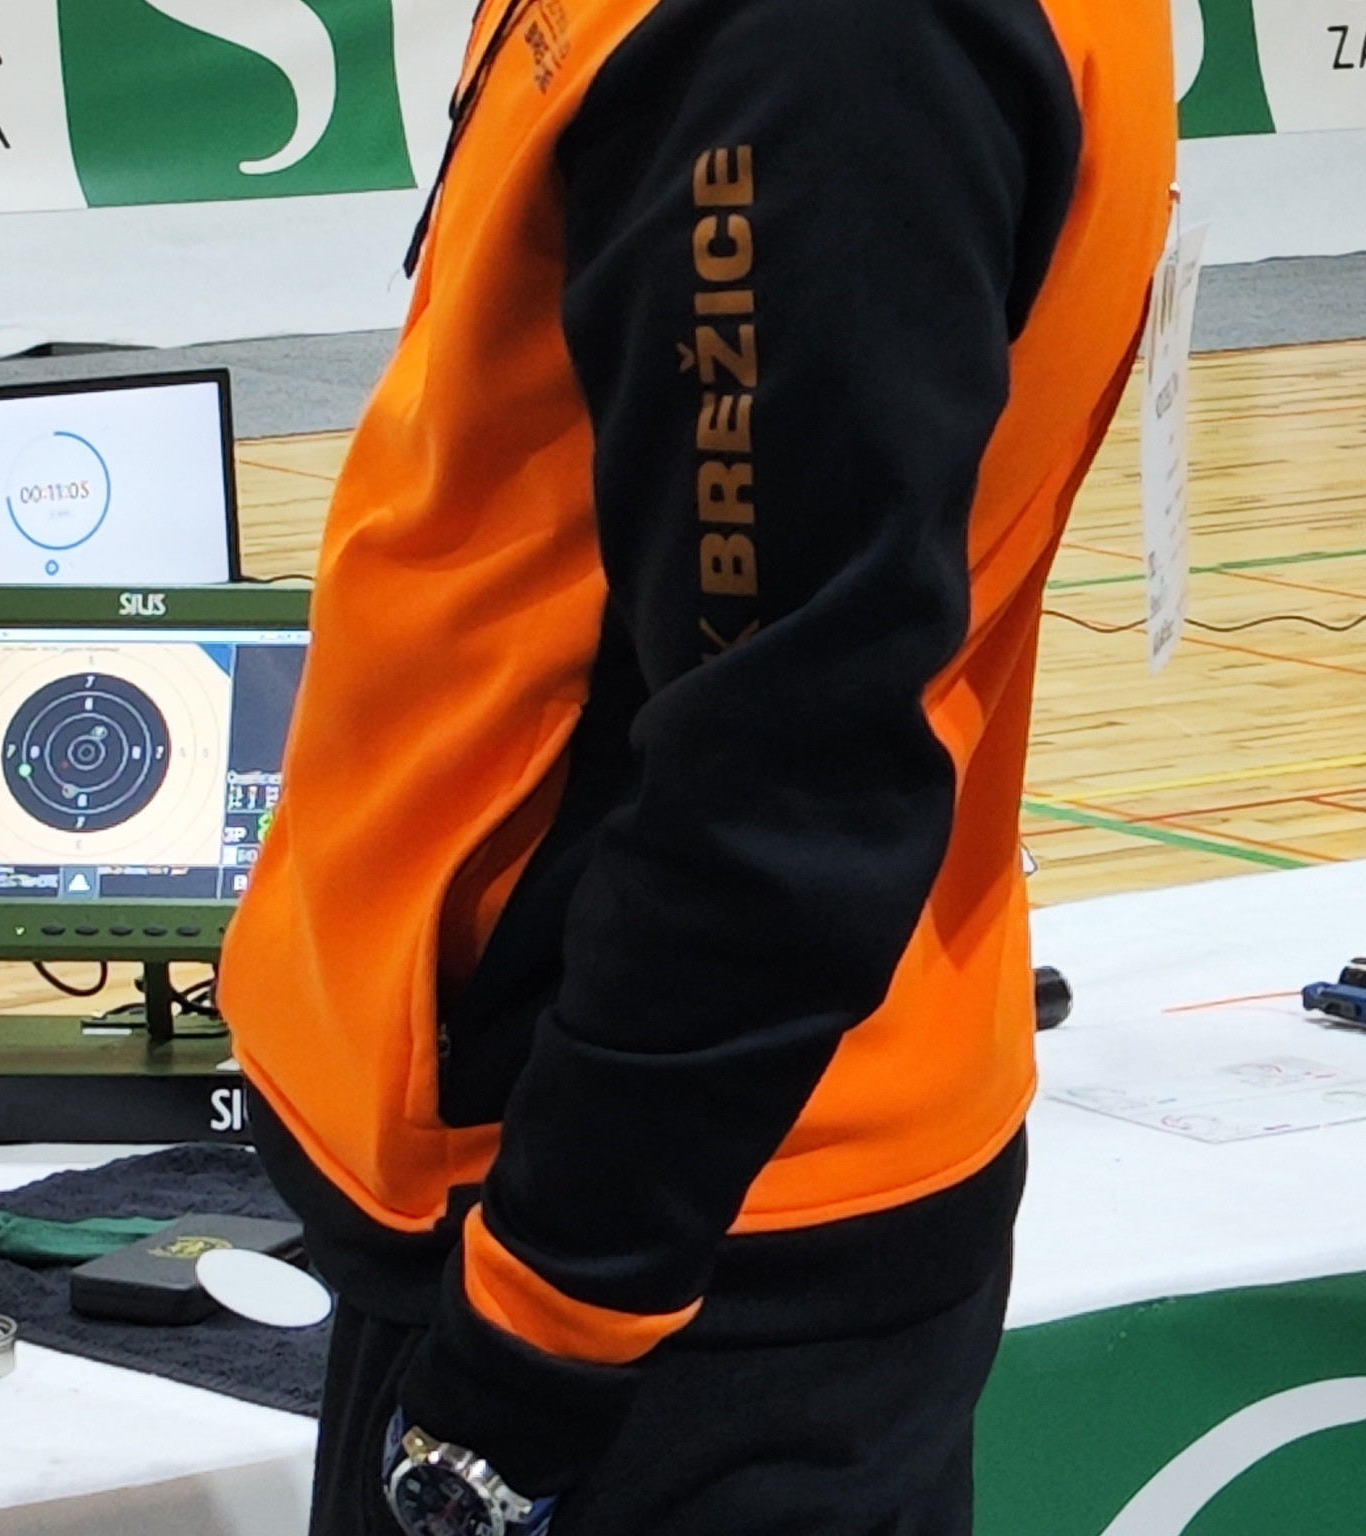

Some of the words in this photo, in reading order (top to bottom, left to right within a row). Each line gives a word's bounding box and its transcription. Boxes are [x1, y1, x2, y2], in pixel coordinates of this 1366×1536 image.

[678, 143, 757, 597] BREŽICE
[19, 480, 90, 504] 00:11:05
[119, 592, 168, 616] SIUS
[210, 1088, 251, 1132] SI
